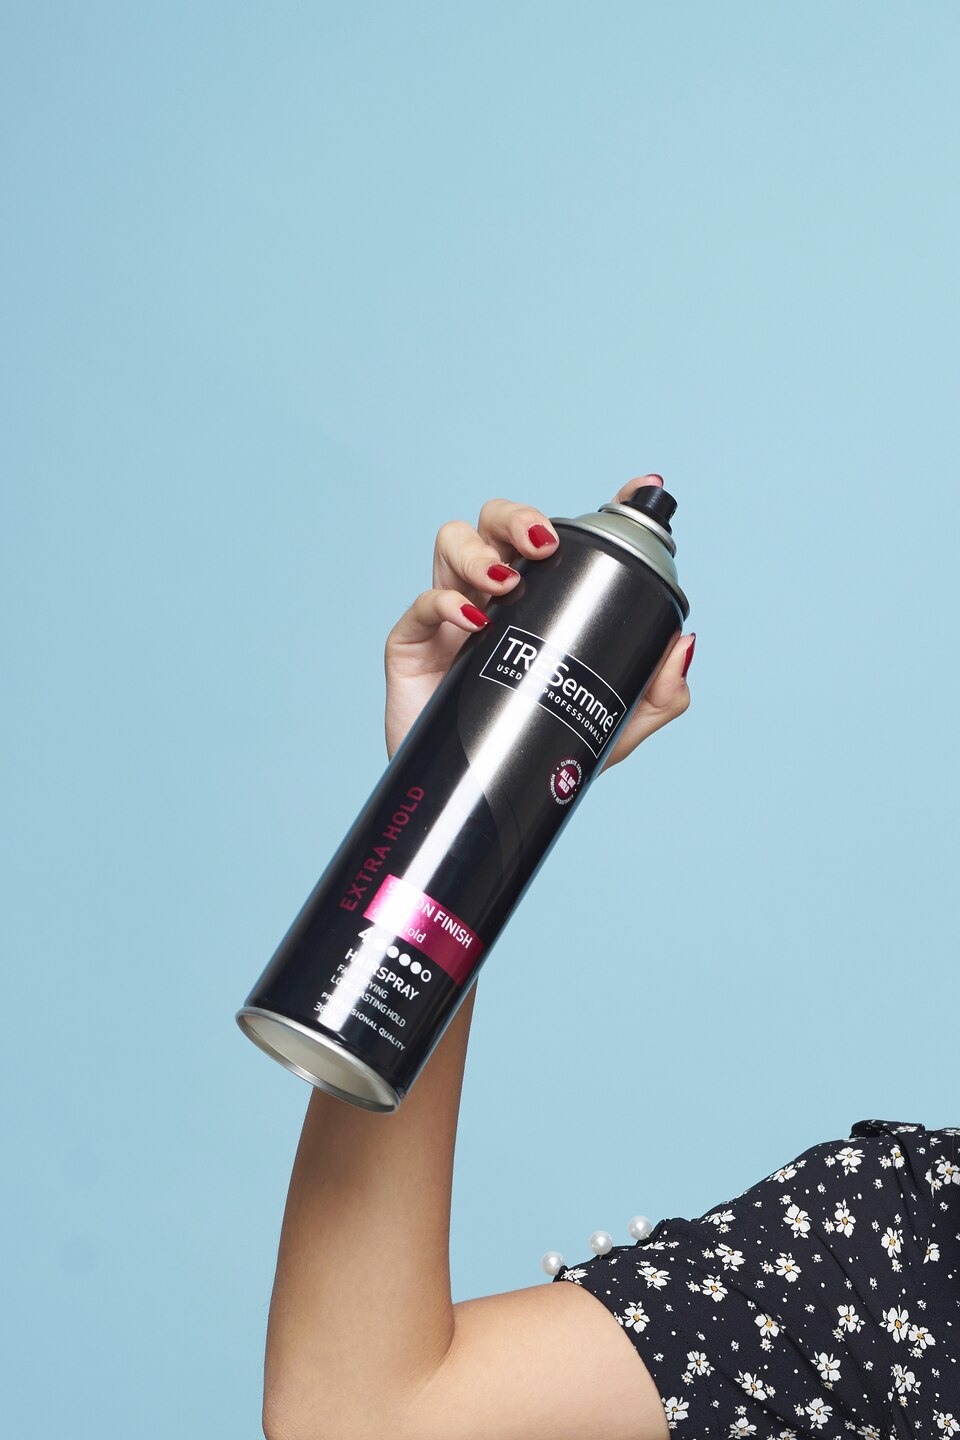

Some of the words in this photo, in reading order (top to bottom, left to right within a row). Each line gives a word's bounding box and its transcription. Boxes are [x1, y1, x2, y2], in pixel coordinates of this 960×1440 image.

[496, 664, 523, 681] USED
[541, 688, 604, 745] PROFESSIONALS
[339, 846, 392, 912] EXTRA
[383, 786, 425, 840] HOLD
[385, 881, 436, 918] SON
[433, 910, 473, 949] FINISH
[352, 986, 389, 1013] ASTING
[385, 1008, 406, 1027] HOLD
[356, 975, 389, 999] RYING
[378, 1027, 406, 1051] QUALITY
